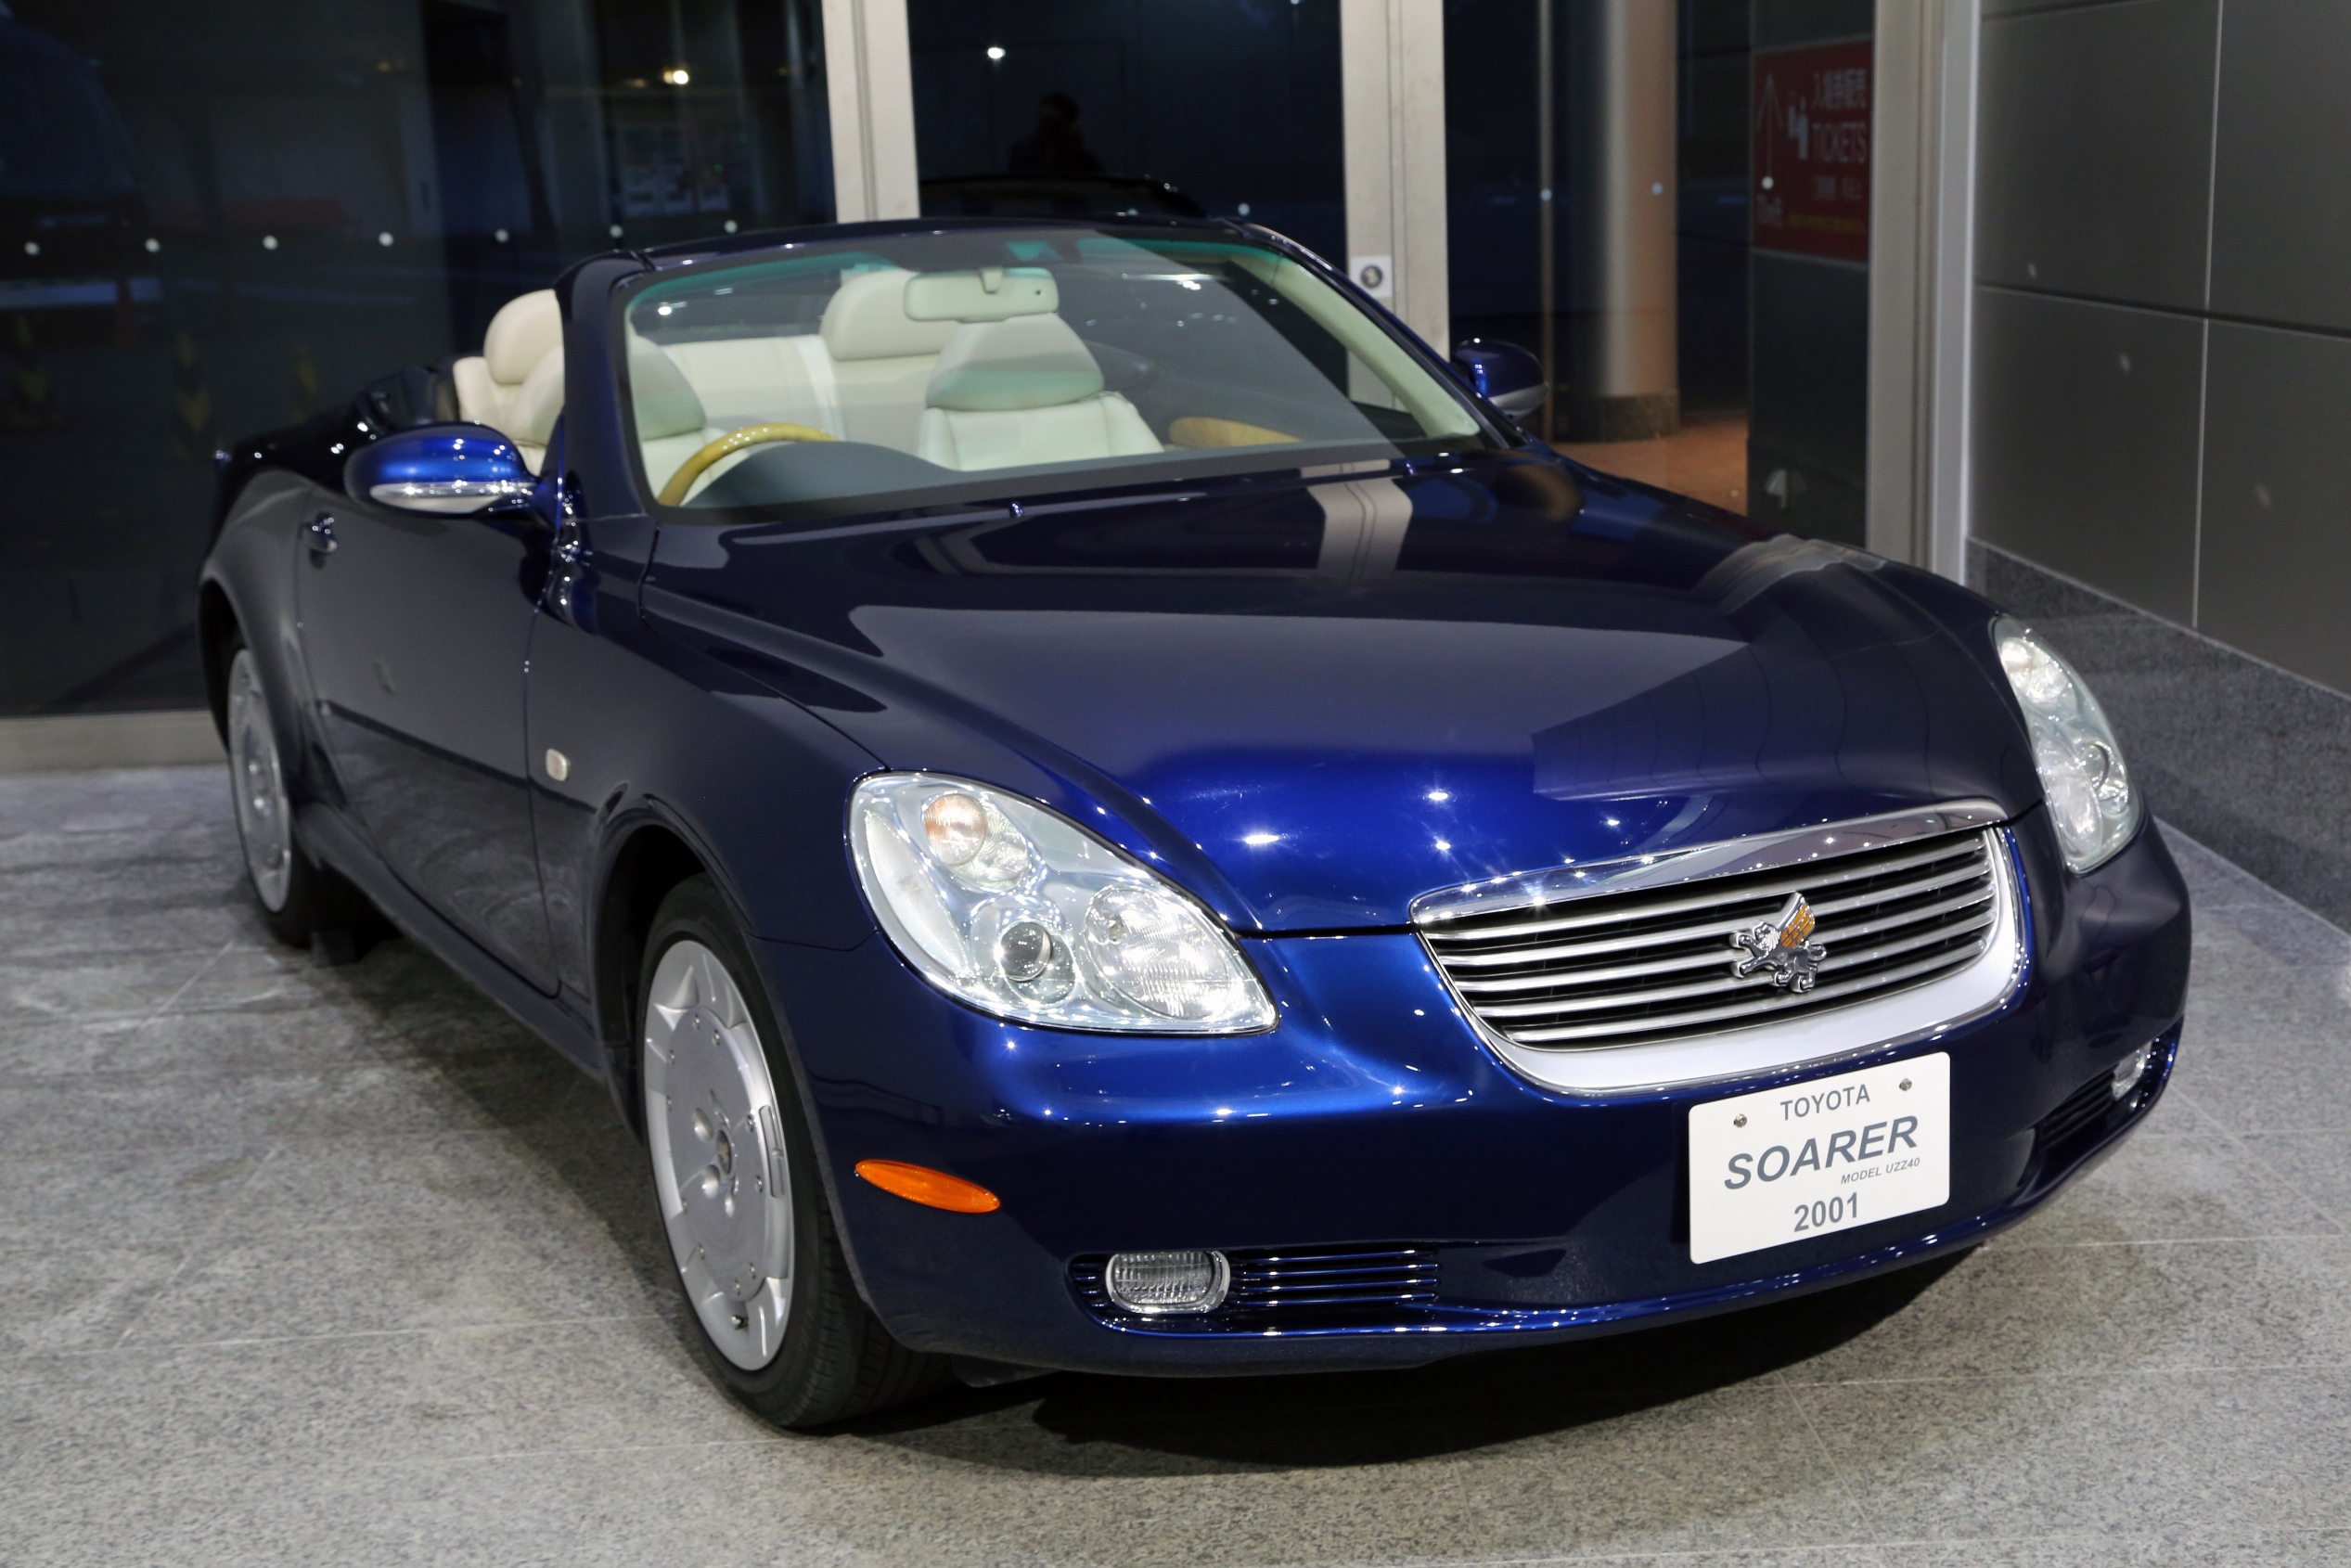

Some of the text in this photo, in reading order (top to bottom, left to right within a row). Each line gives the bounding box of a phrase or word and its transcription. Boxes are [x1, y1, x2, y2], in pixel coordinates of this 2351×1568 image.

[1812, 121, 1868, 164] TICKETS
[1779, 1084, 1871, 1121] TOYOTA
[1724, 1115, 1919, 1190] SOARER
[1841, 1157, 1921, 1185] MODEL UZZ40
[1793, 1191, 1857, 1233] 2001
